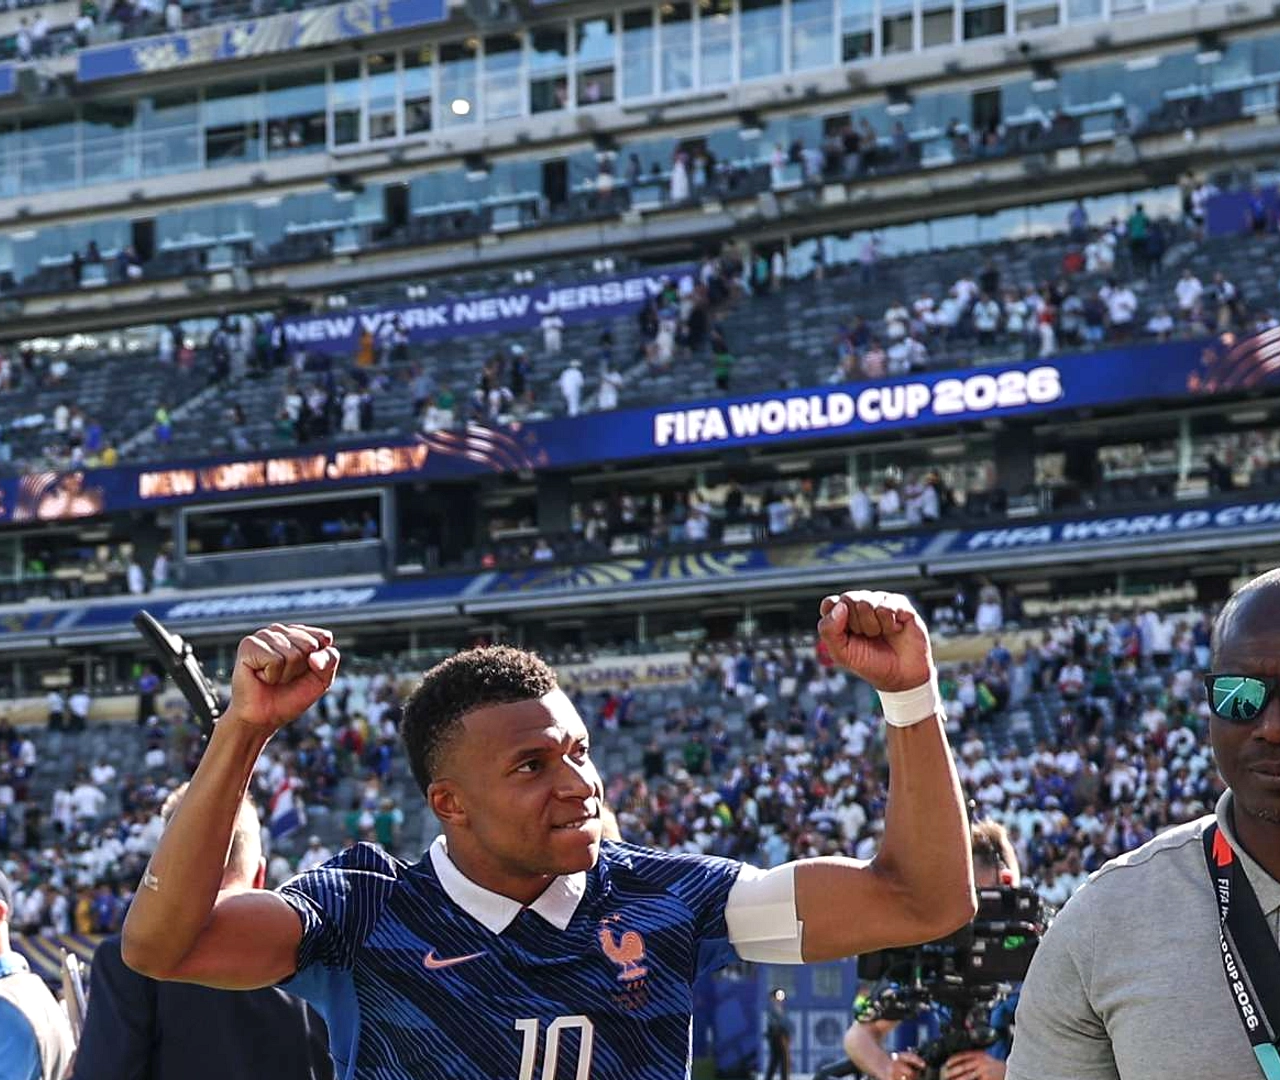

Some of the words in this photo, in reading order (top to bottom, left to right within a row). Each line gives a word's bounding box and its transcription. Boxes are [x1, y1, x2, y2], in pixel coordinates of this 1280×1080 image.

[284, 316, 354, 343] NEW
[453, 294, 532, 324] NEW
[654, 407, 727, 446] FIFA
[729, 391, 855, 438] WORLD
[857, 383, 932, 424] CUP
[932, 367, 1062, 415] 2026
[139, 469, 196, 498] NEW
[265, 454, 326, 486] NEW
[327, 444, 428, 480] JERSEY
[968, 526, 1051, 551] FIFA
[1061, 509, 1210, 542] WORLD
[1218, 878, 1230, 903] FIFA
[1224, 954, 1239, 981] CUP
[1233, 980, 1259, 1030] 2026
